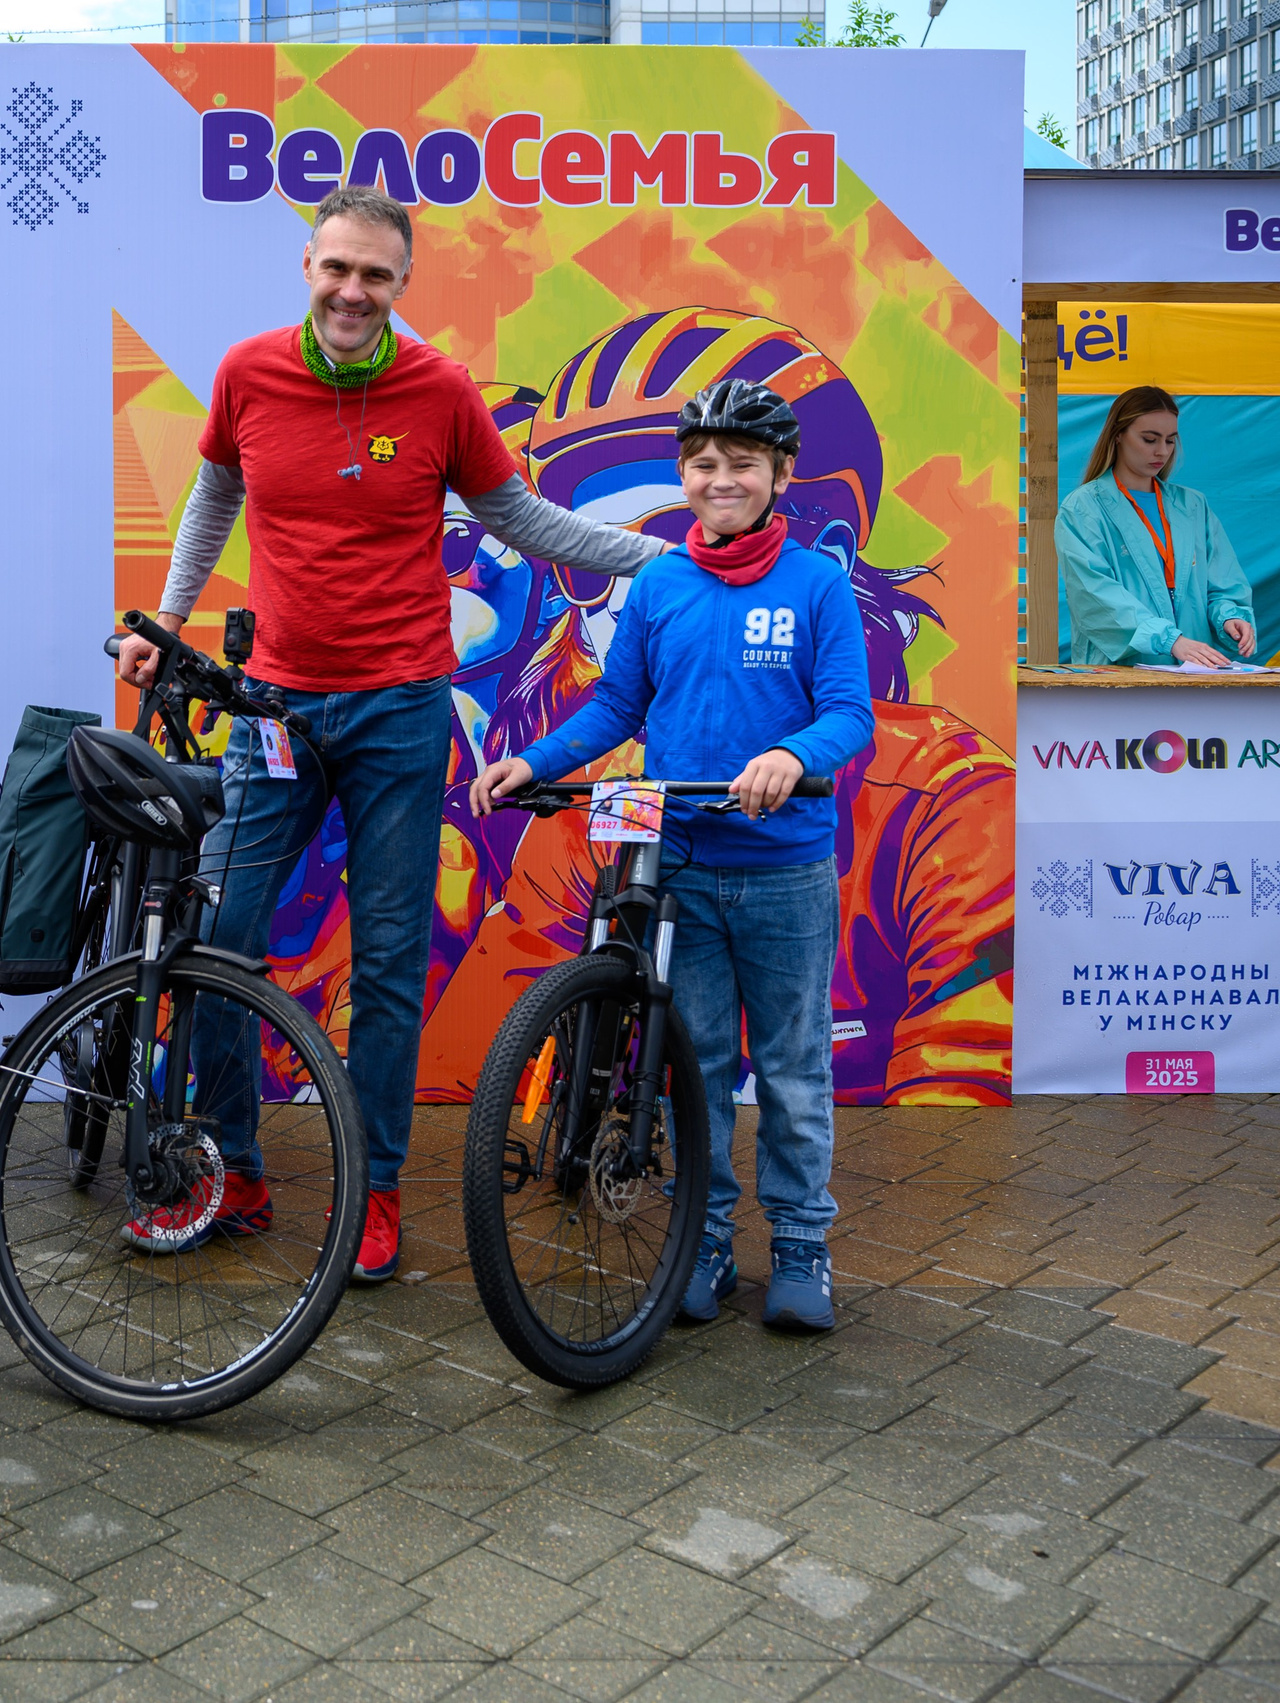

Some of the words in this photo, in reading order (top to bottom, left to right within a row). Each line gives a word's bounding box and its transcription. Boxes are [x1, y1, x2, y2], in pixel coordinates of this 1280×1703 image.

[202, 110, 836, 207] ВелоСемья
[743, 607, 795, 646] 92
[1032, 741, 1111, 769] VIVA
[1115, 729, 1228, 774] KOLA
[1237, 739, 1280, 768] AR
[591, 820, 617, 829] 06927
[634, 845, 645, 881] PECT
[1103, 859, 1242, 896] VIVA
[1143, 901, 1202, 931] Ровар
[1073, 964, 1269, 982] МІЖНАРОДНЫ
[1062, 989, 1280, 1005] ВЕЛАКАРНАВАЛ
[1099, 1015, 1113, 1031] У
[1127, 1014, 1233, 1030] МІНСКУ
[1145, 1058, 1160, 1070] 31
[1165, 1058, 1193, 1069] МАЯ
[1145, 1070, 1199, 1086] 2025
